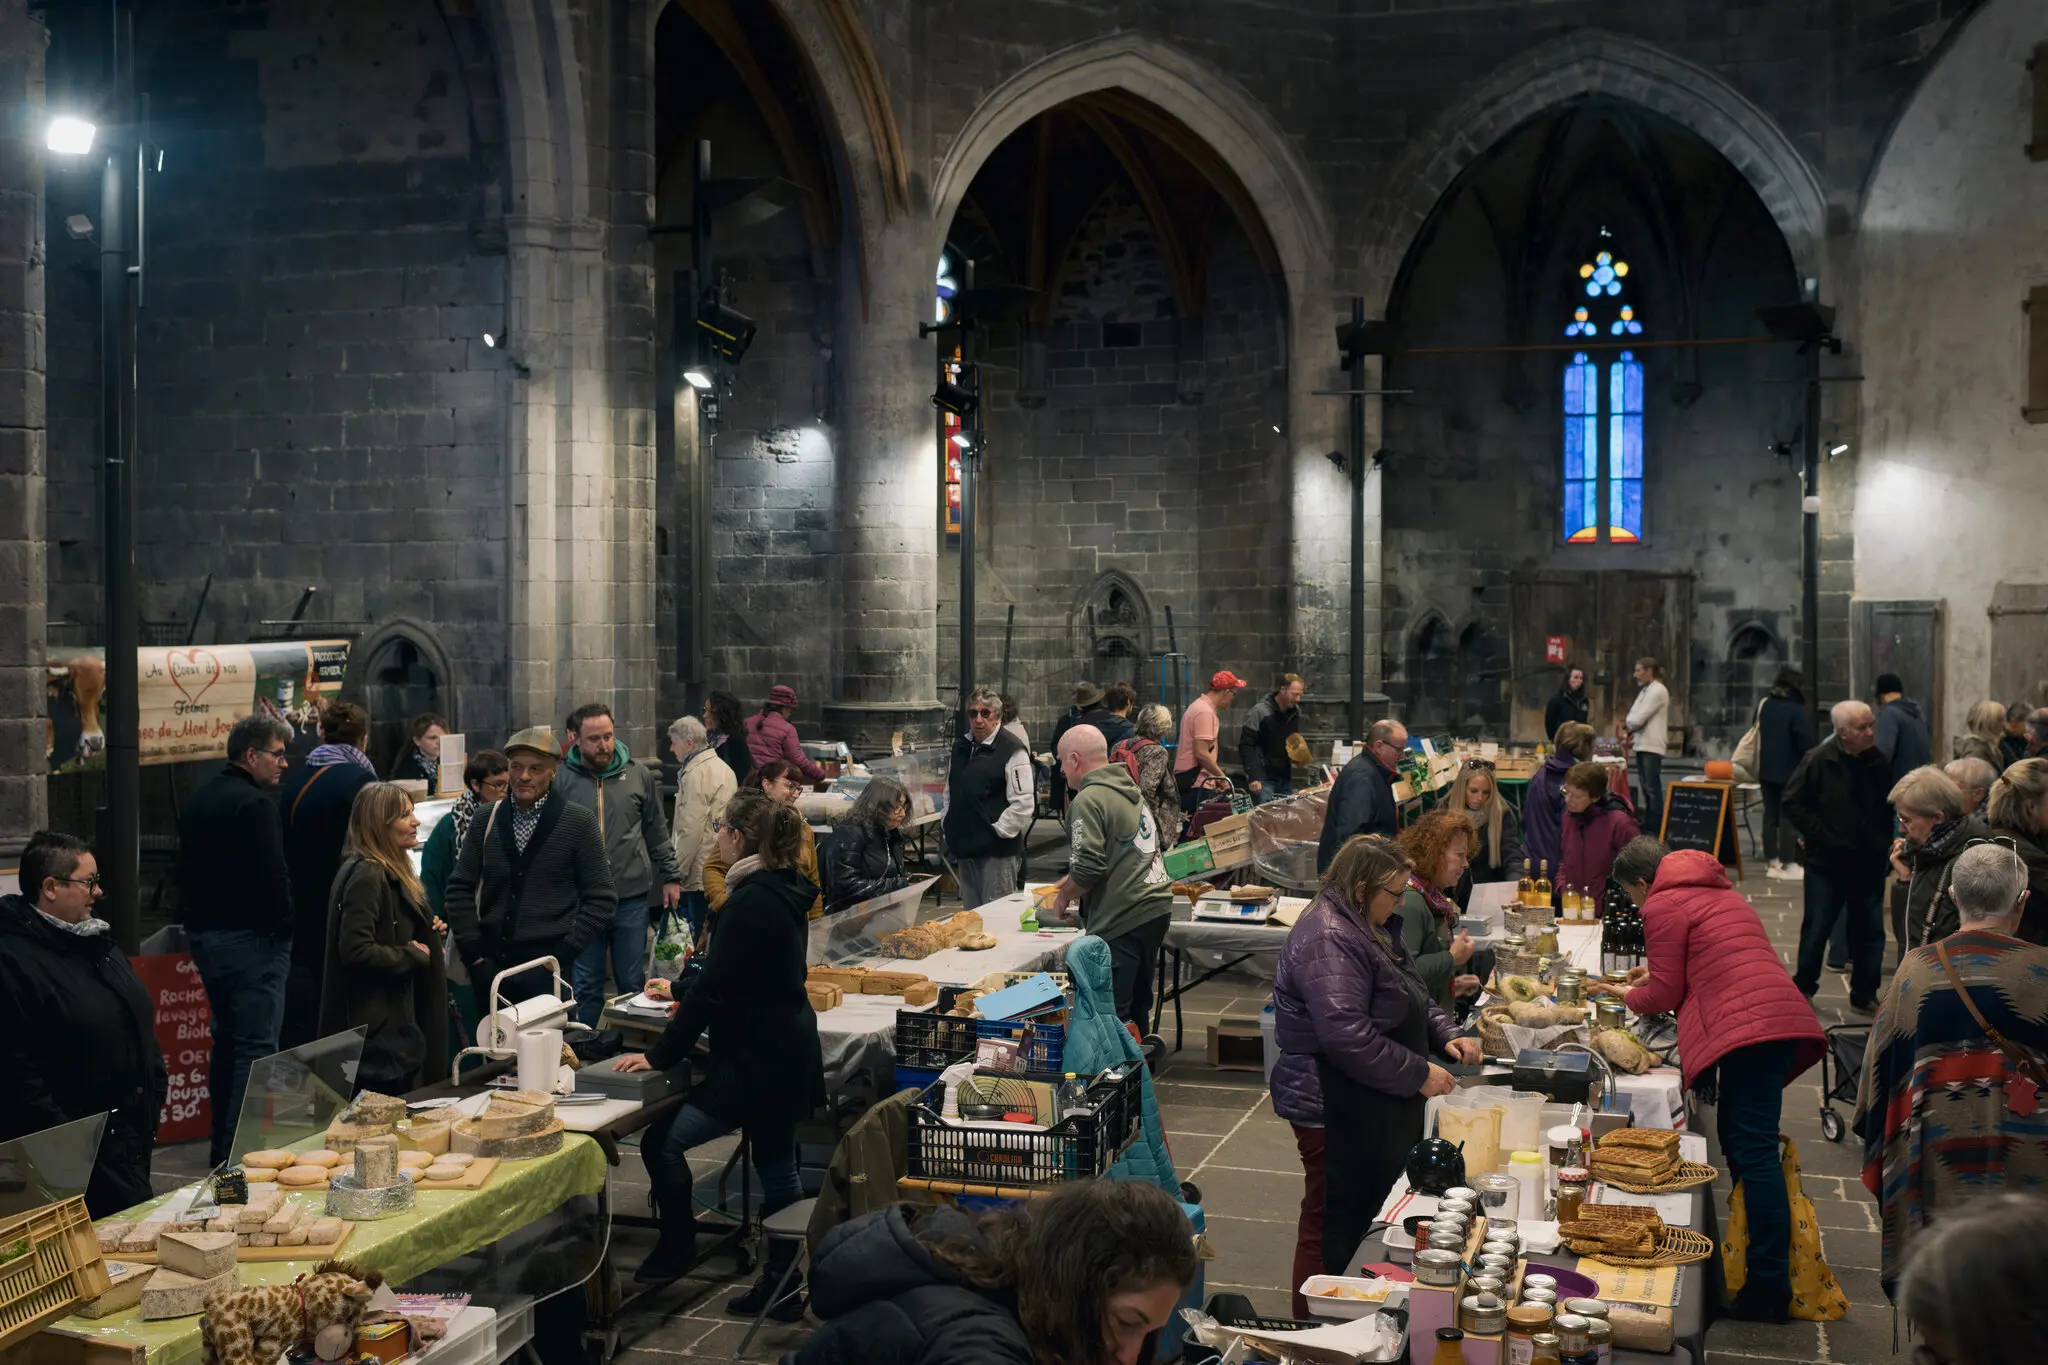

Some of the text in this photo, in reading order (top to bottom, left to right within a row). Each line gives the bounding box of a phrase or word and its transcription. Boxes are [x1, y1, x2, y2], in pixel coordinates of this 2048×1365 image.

[145, 664, 163, 678] Au
[174, 700, 210, 715] Fermes
[158, 721, 171, 738] du
[175, 719, 208, 737] Mont
